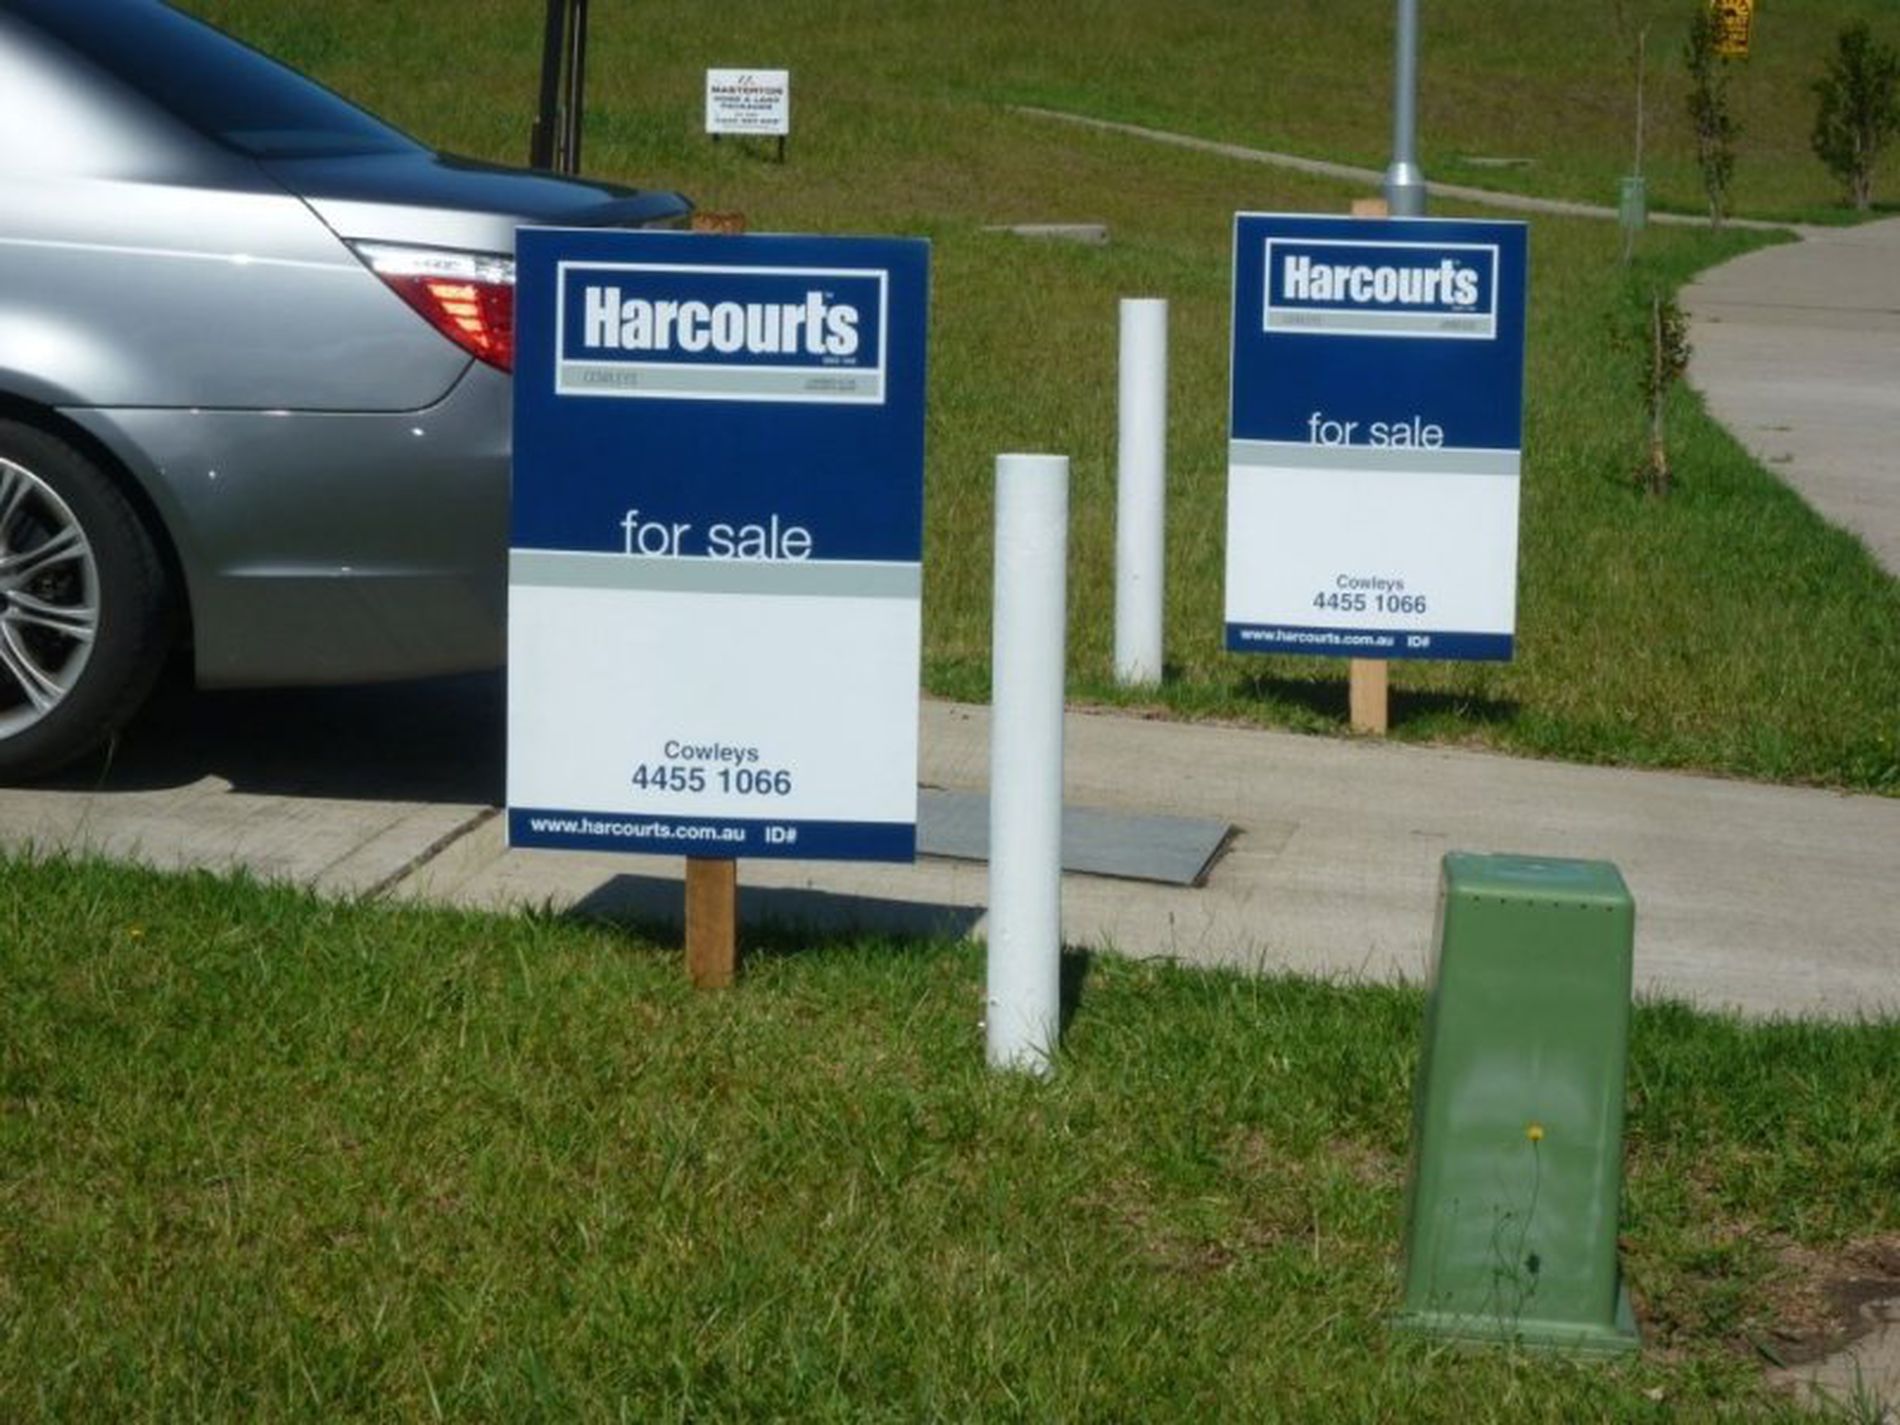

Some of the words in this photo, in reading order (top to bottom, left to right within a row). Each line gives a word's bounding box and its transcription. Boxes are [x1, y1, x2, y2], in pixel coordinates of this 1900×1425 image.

[1284, 255, 1479, 305] Harcourts
[585, 286, 858, 356] Harcourts
[1308, 411, 1360, 447] for
[1369, 414, 1444, 451] sale
[620, 509, 691, 558] for
[707, 513, 812, 561] sale
[1336, 574, 1404, 592] Cowleys
[1313, 591, 1366, 612] 4455
[1376, 594, 1427, 614] 1066
[1240, 628, 1395, 647] www.harcourts.com.au
[1407, 635, 1430, 648] ID#
[664, 740, 760, 767] Cowleys
[632, 764, 705, 793] 4455
[717, 768, 792, 796] 1066
[530, 816, 746, 842] www.harcourts.com.au
[765, 826, 797, 844] ID#
